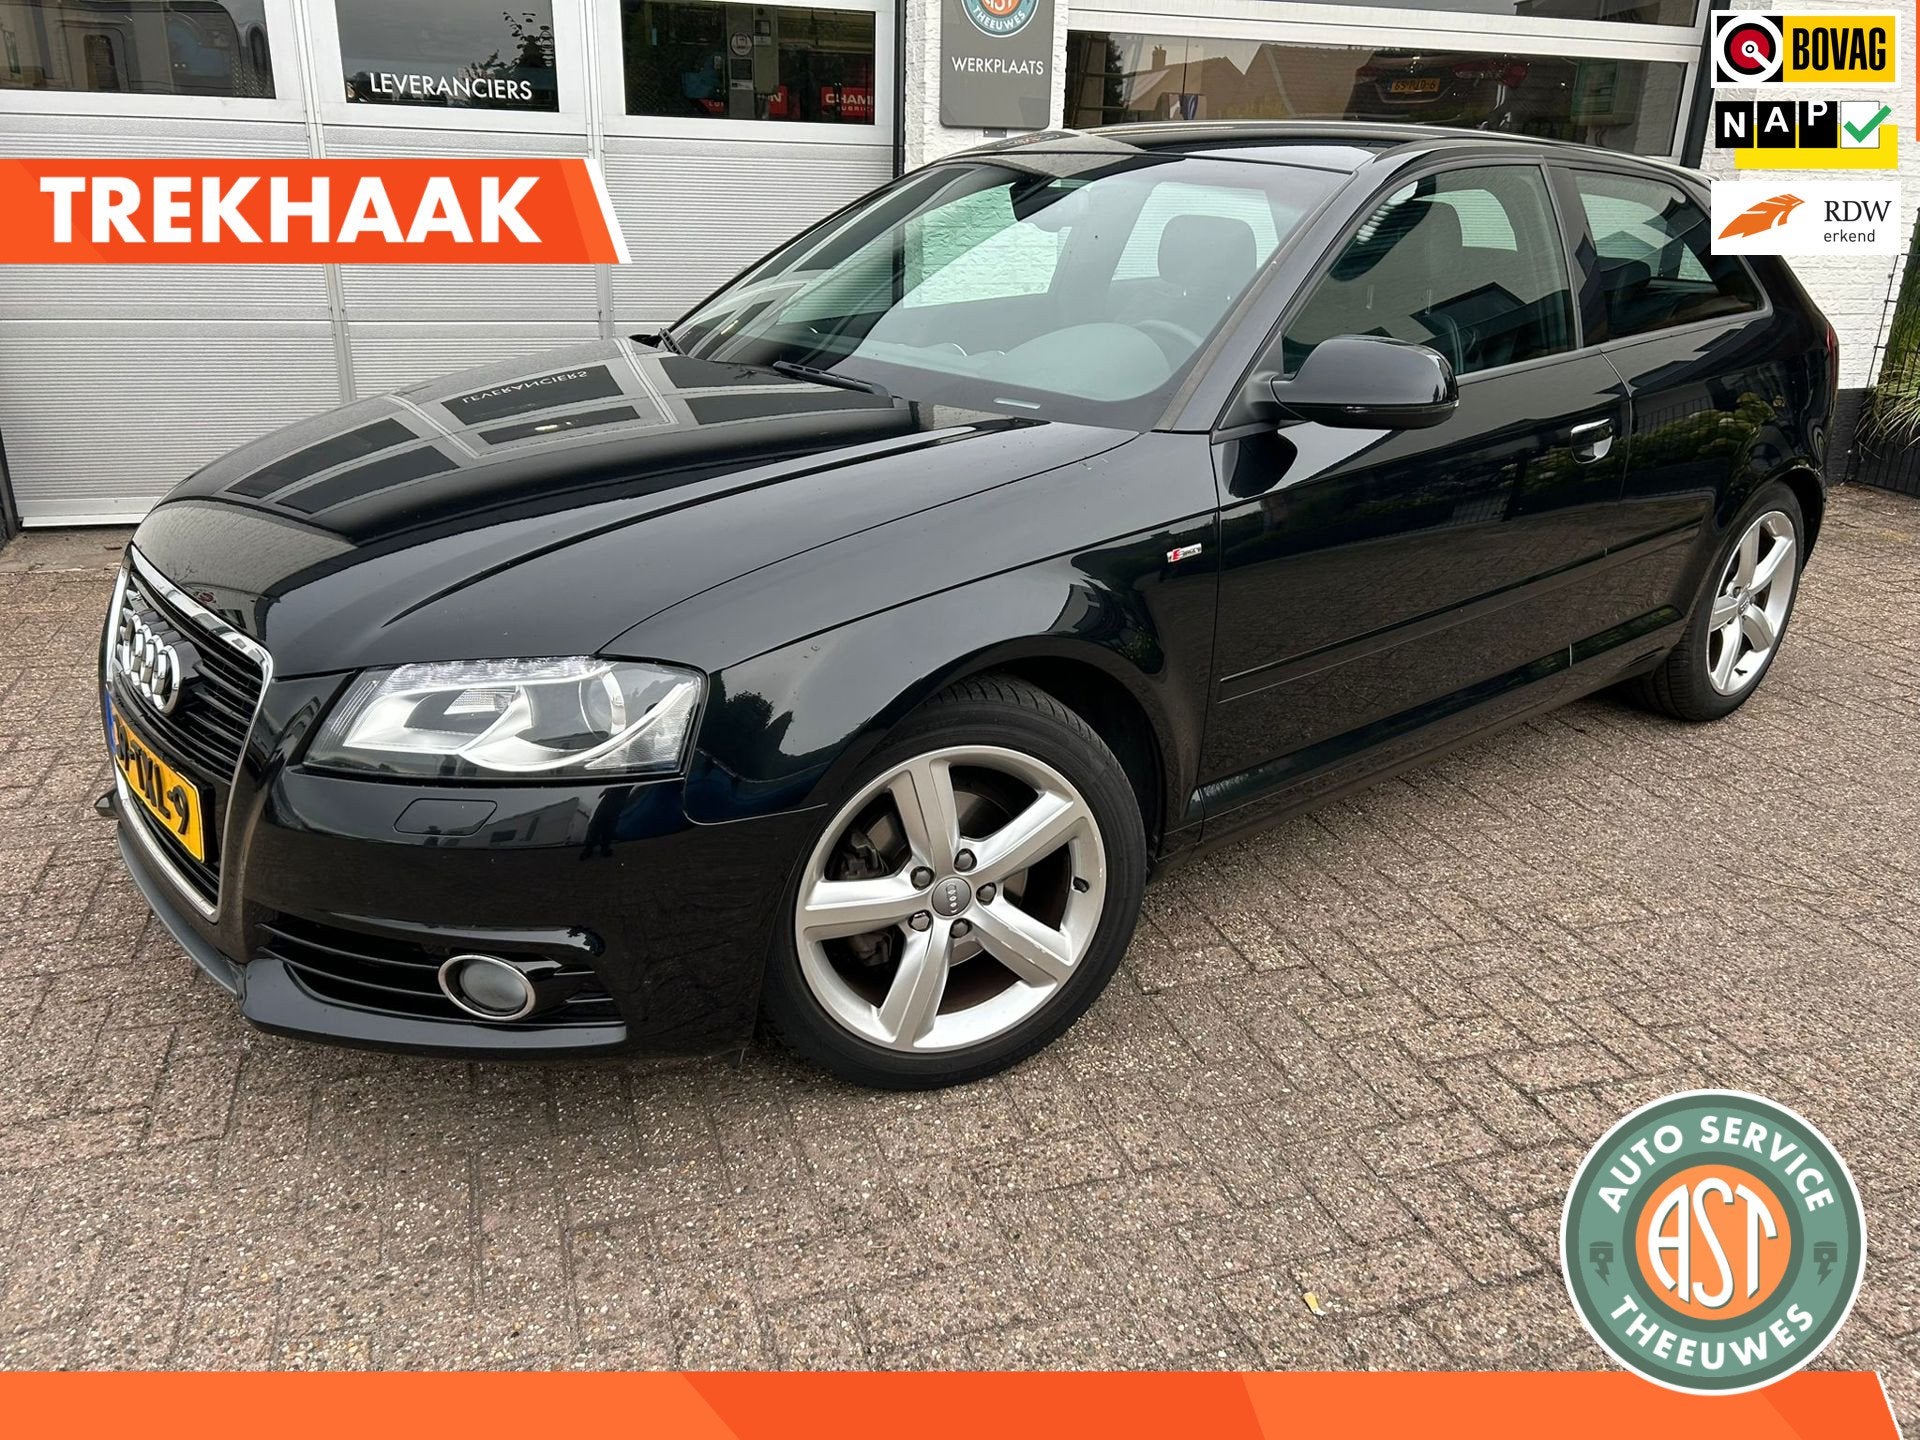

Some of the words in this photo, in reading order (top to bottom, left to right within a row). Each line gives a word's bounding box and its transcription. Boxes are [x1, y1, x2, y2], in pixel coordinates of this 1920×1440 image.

[973, 4, 1026, 30] THEEUWES
[951, 56, 1044, 76] WERKPLAATS
[369, 72, 533, 100] LEVERANCIERS
